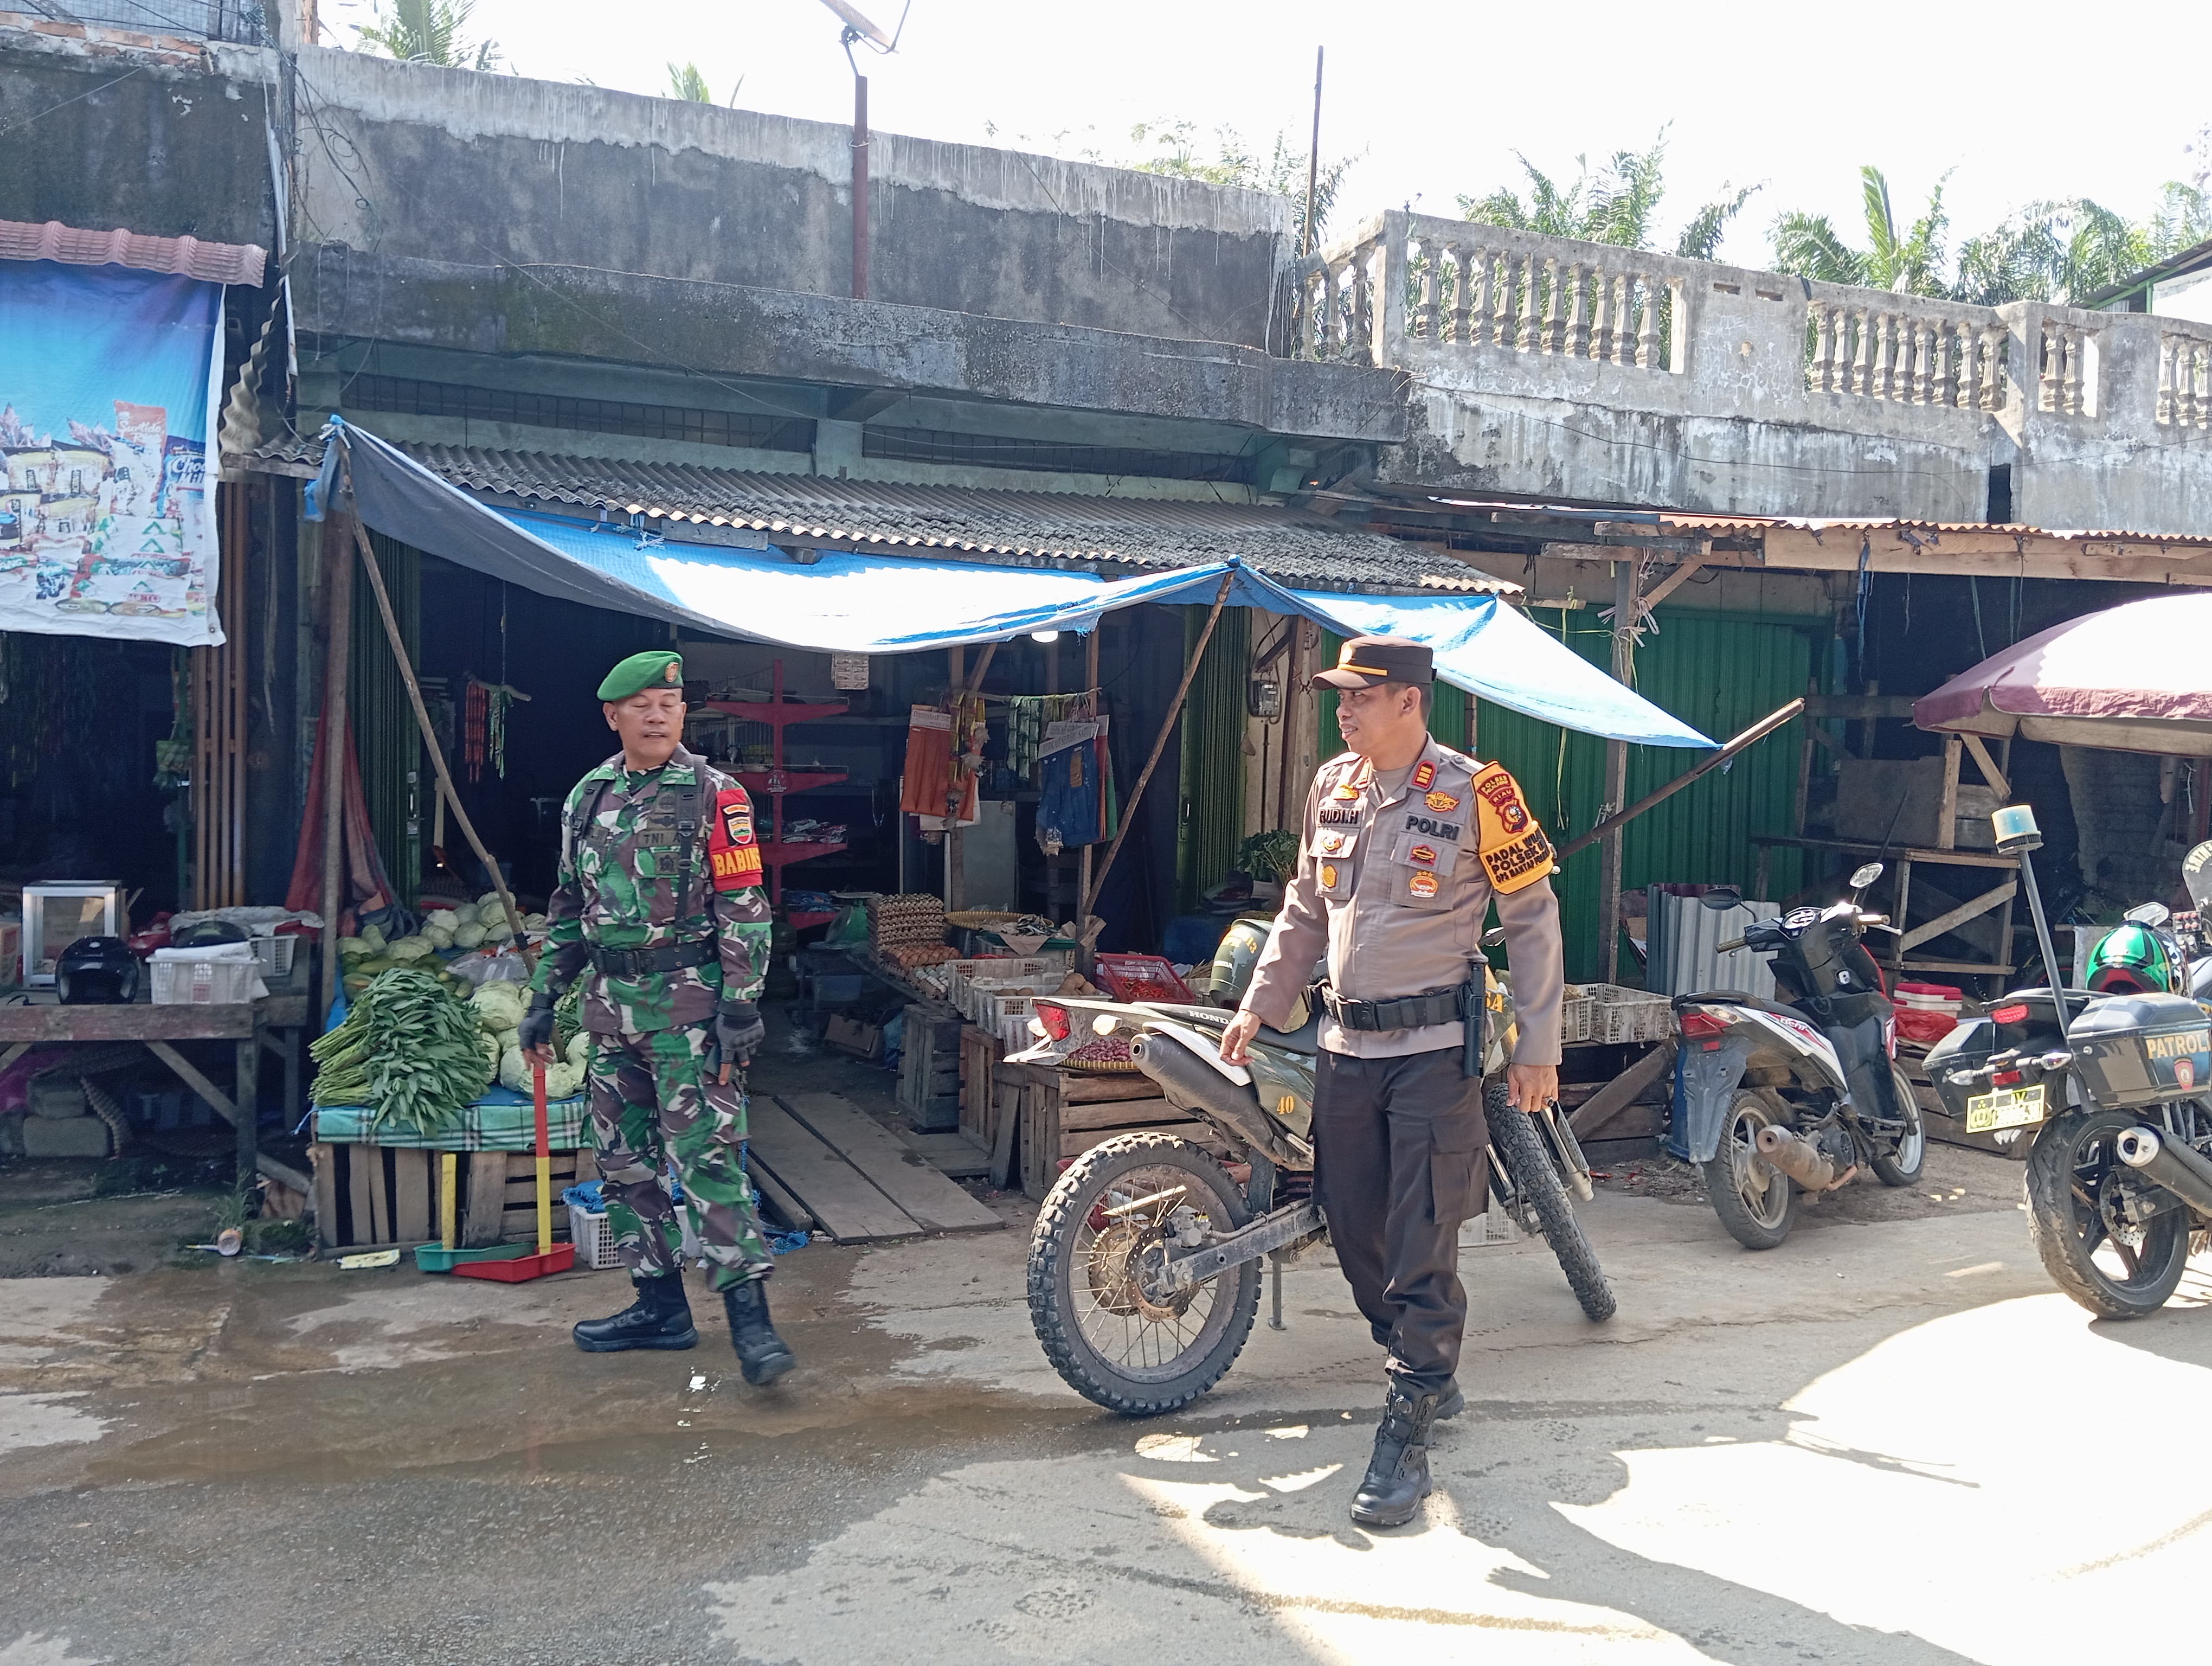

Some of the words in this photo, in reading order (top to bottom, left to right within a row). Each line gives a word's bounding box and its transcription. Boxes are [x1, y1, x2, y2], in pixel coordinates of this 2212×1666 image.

[1493, 790, 1512, 803] RIAU
[1406, 815, 1459, 841] POLRI
[644, 834, 664, 844] TNI
[1486, 843, 1524, 866] PADAL
[1491, 845, 1540, 874] POLSEK
[1495, 874, 1509, 884] OPS
[1188, 1010, 1231, 1024] HOND
[2146, 1031, 2211, 1060] PATROLI
[1276, 1095, 1294, 1115] 40
